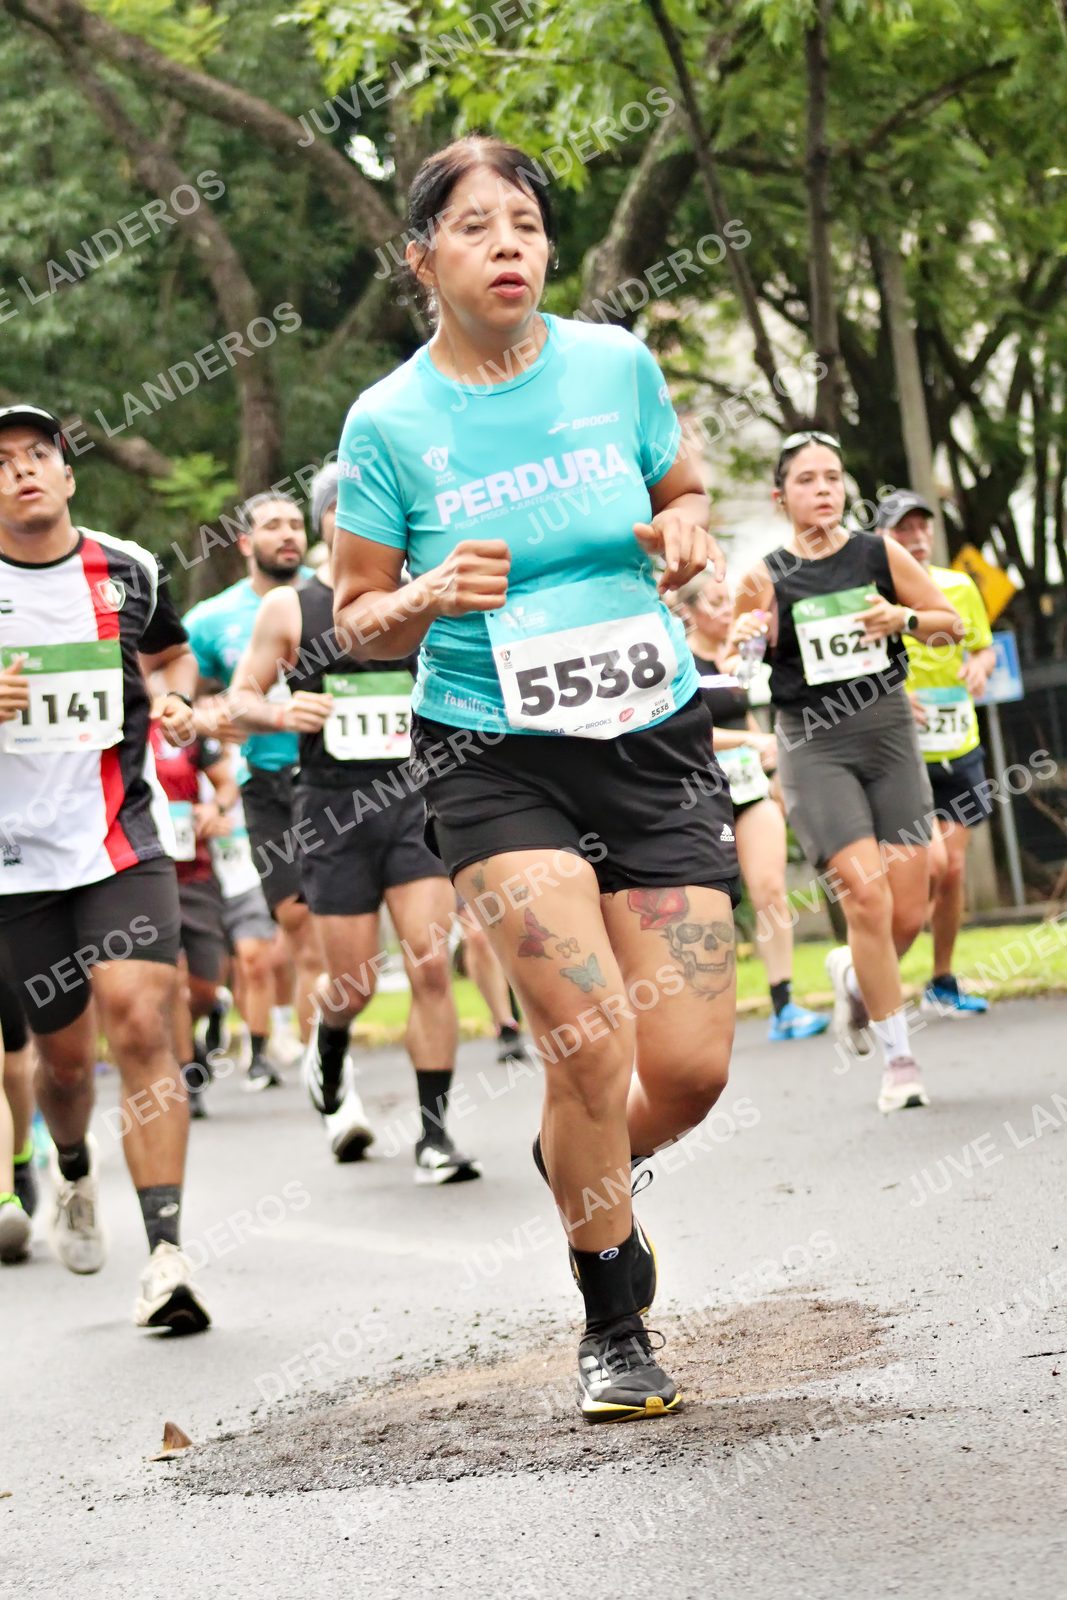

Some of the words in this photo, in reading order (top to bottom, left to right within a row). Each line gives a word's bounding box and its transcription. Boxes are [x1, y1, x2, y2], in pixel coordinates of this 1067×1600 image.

[572, 411, 620, 430] BROOKS
[435, 443, 630, 526] PERDURA
[515, 642, 666, 717] 5538
[651, 703, 670, 718] 5538
[337, 713, 409, 736] 1113
[585, 718, 612, 729] BROOKS
